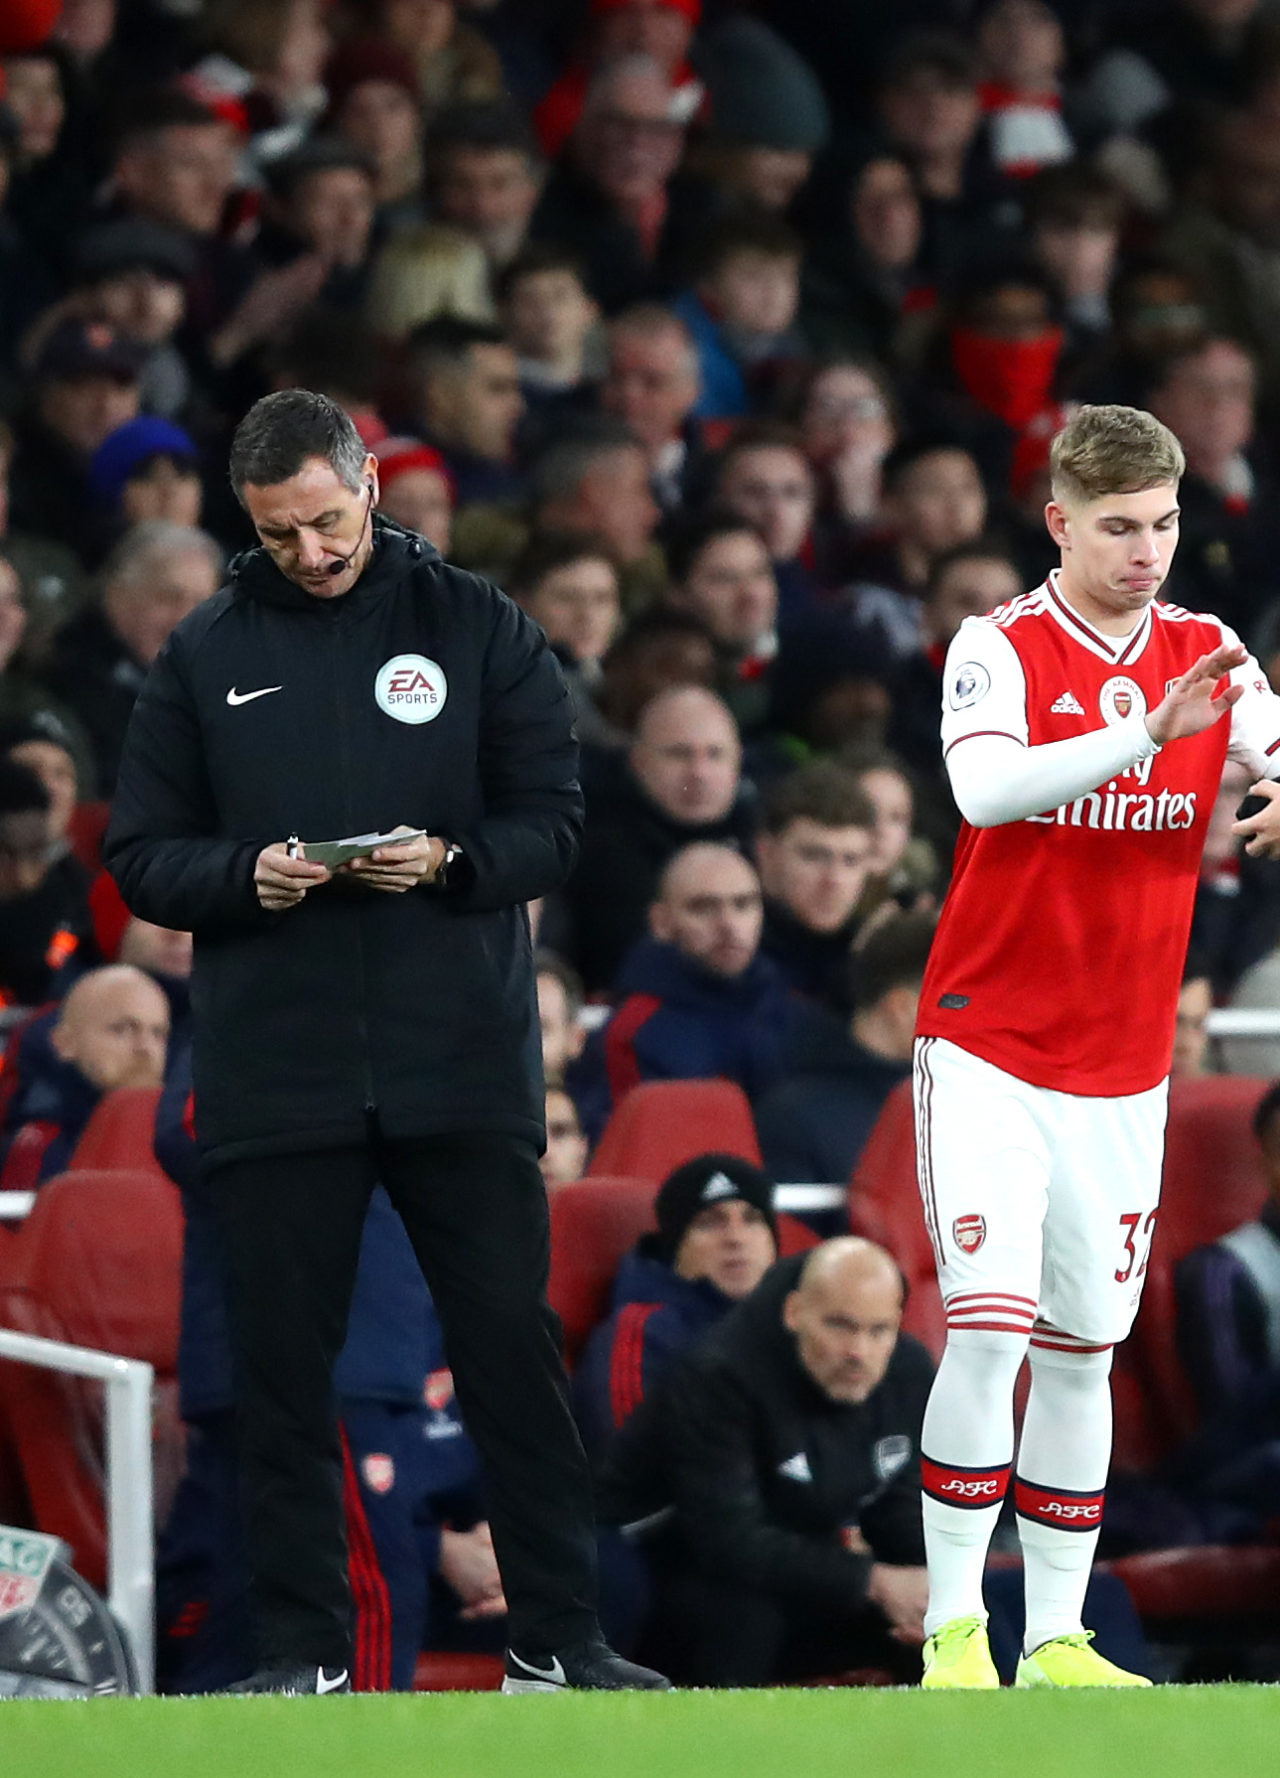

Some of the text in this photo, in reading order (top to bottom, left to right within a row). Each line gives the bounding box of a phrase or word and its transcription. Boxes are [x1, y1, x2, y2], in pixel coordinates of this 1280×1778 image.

[388, 669, 435, 693] EA
[387, 692, 438, 705] SPORTS
[1025, 781, 1198, 831] mirates
[940, 1479, 998, 1497] AFC
[1038, 1502, 1100, 1519] AFC
